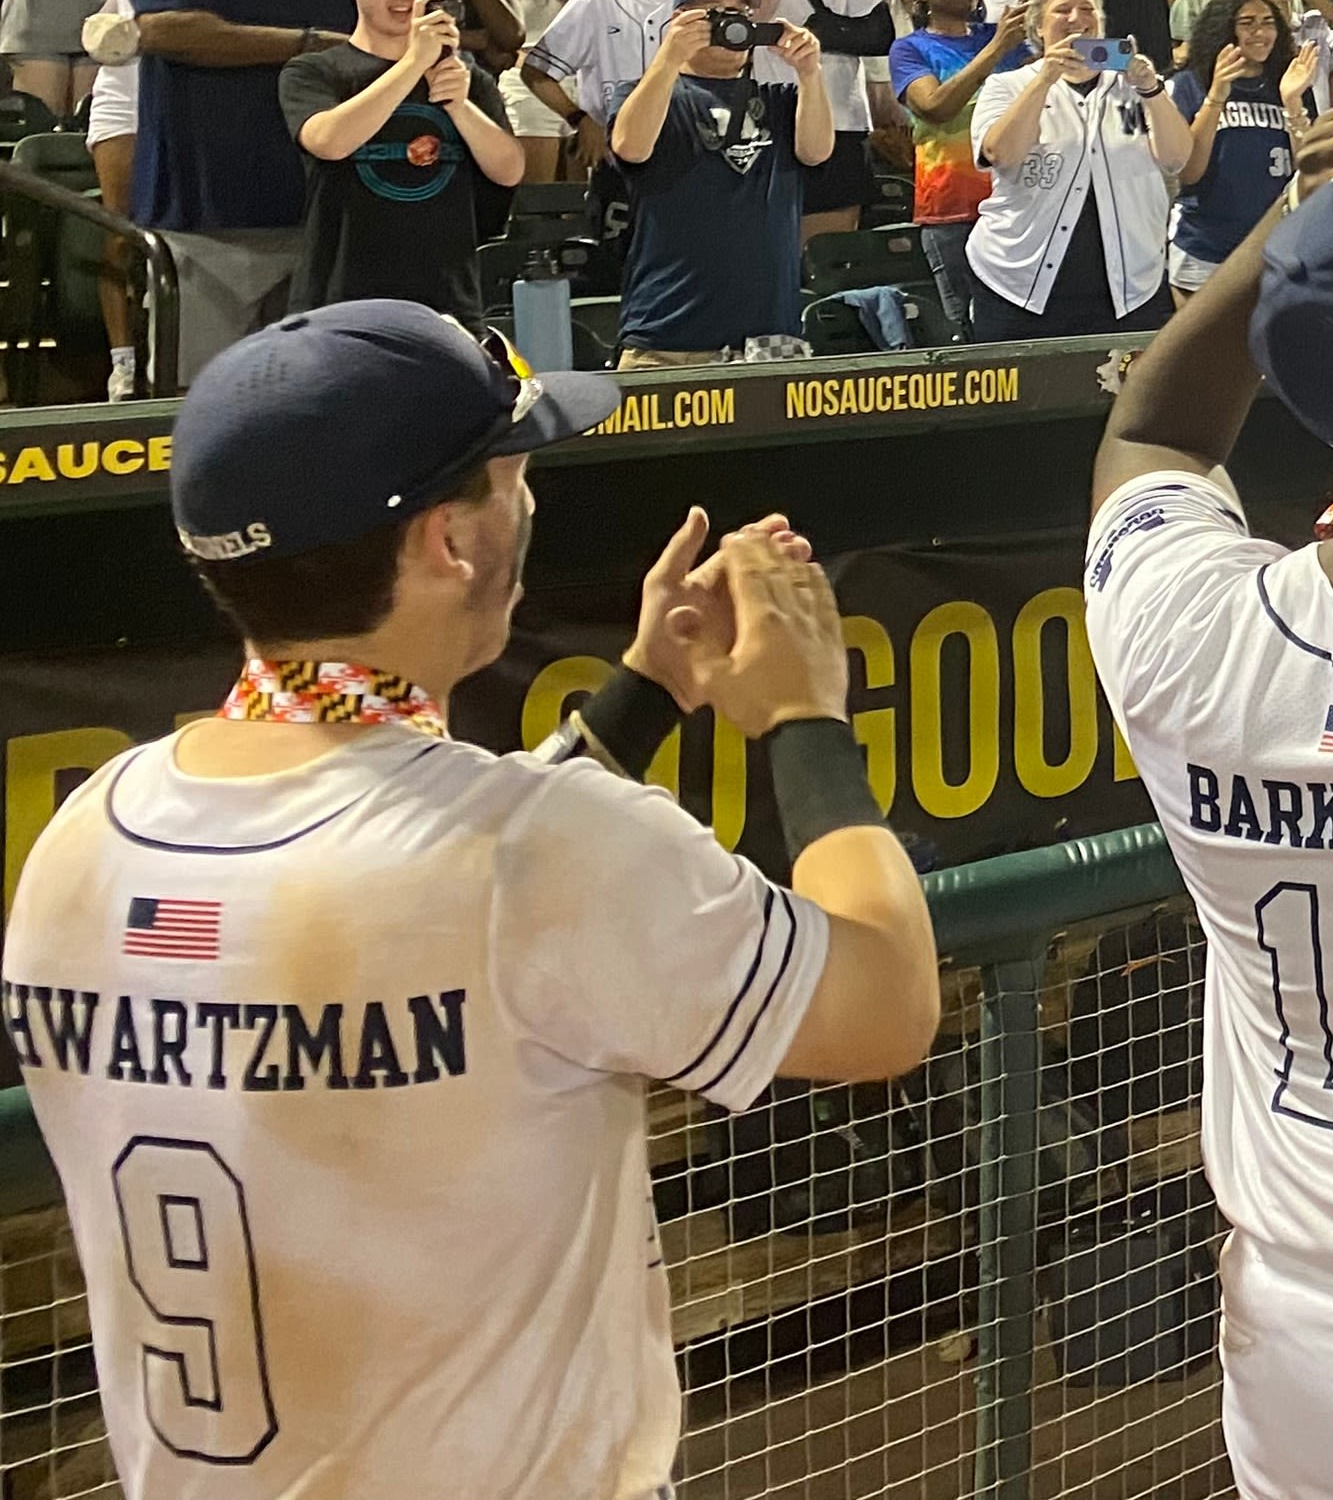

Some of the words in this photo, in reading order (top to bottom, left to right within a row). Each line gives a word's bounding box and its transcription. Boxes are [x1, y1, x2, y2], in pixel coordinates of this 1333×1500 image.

[1022, 151, 1064, 190] 33
[785, 367, 1019, 419] NOSAUCEQUE.COM
[0, 435, 173, 484] AUCE
[840, 587, 1140, 820] GOO
[111, 1135, 279, 1466] 9
